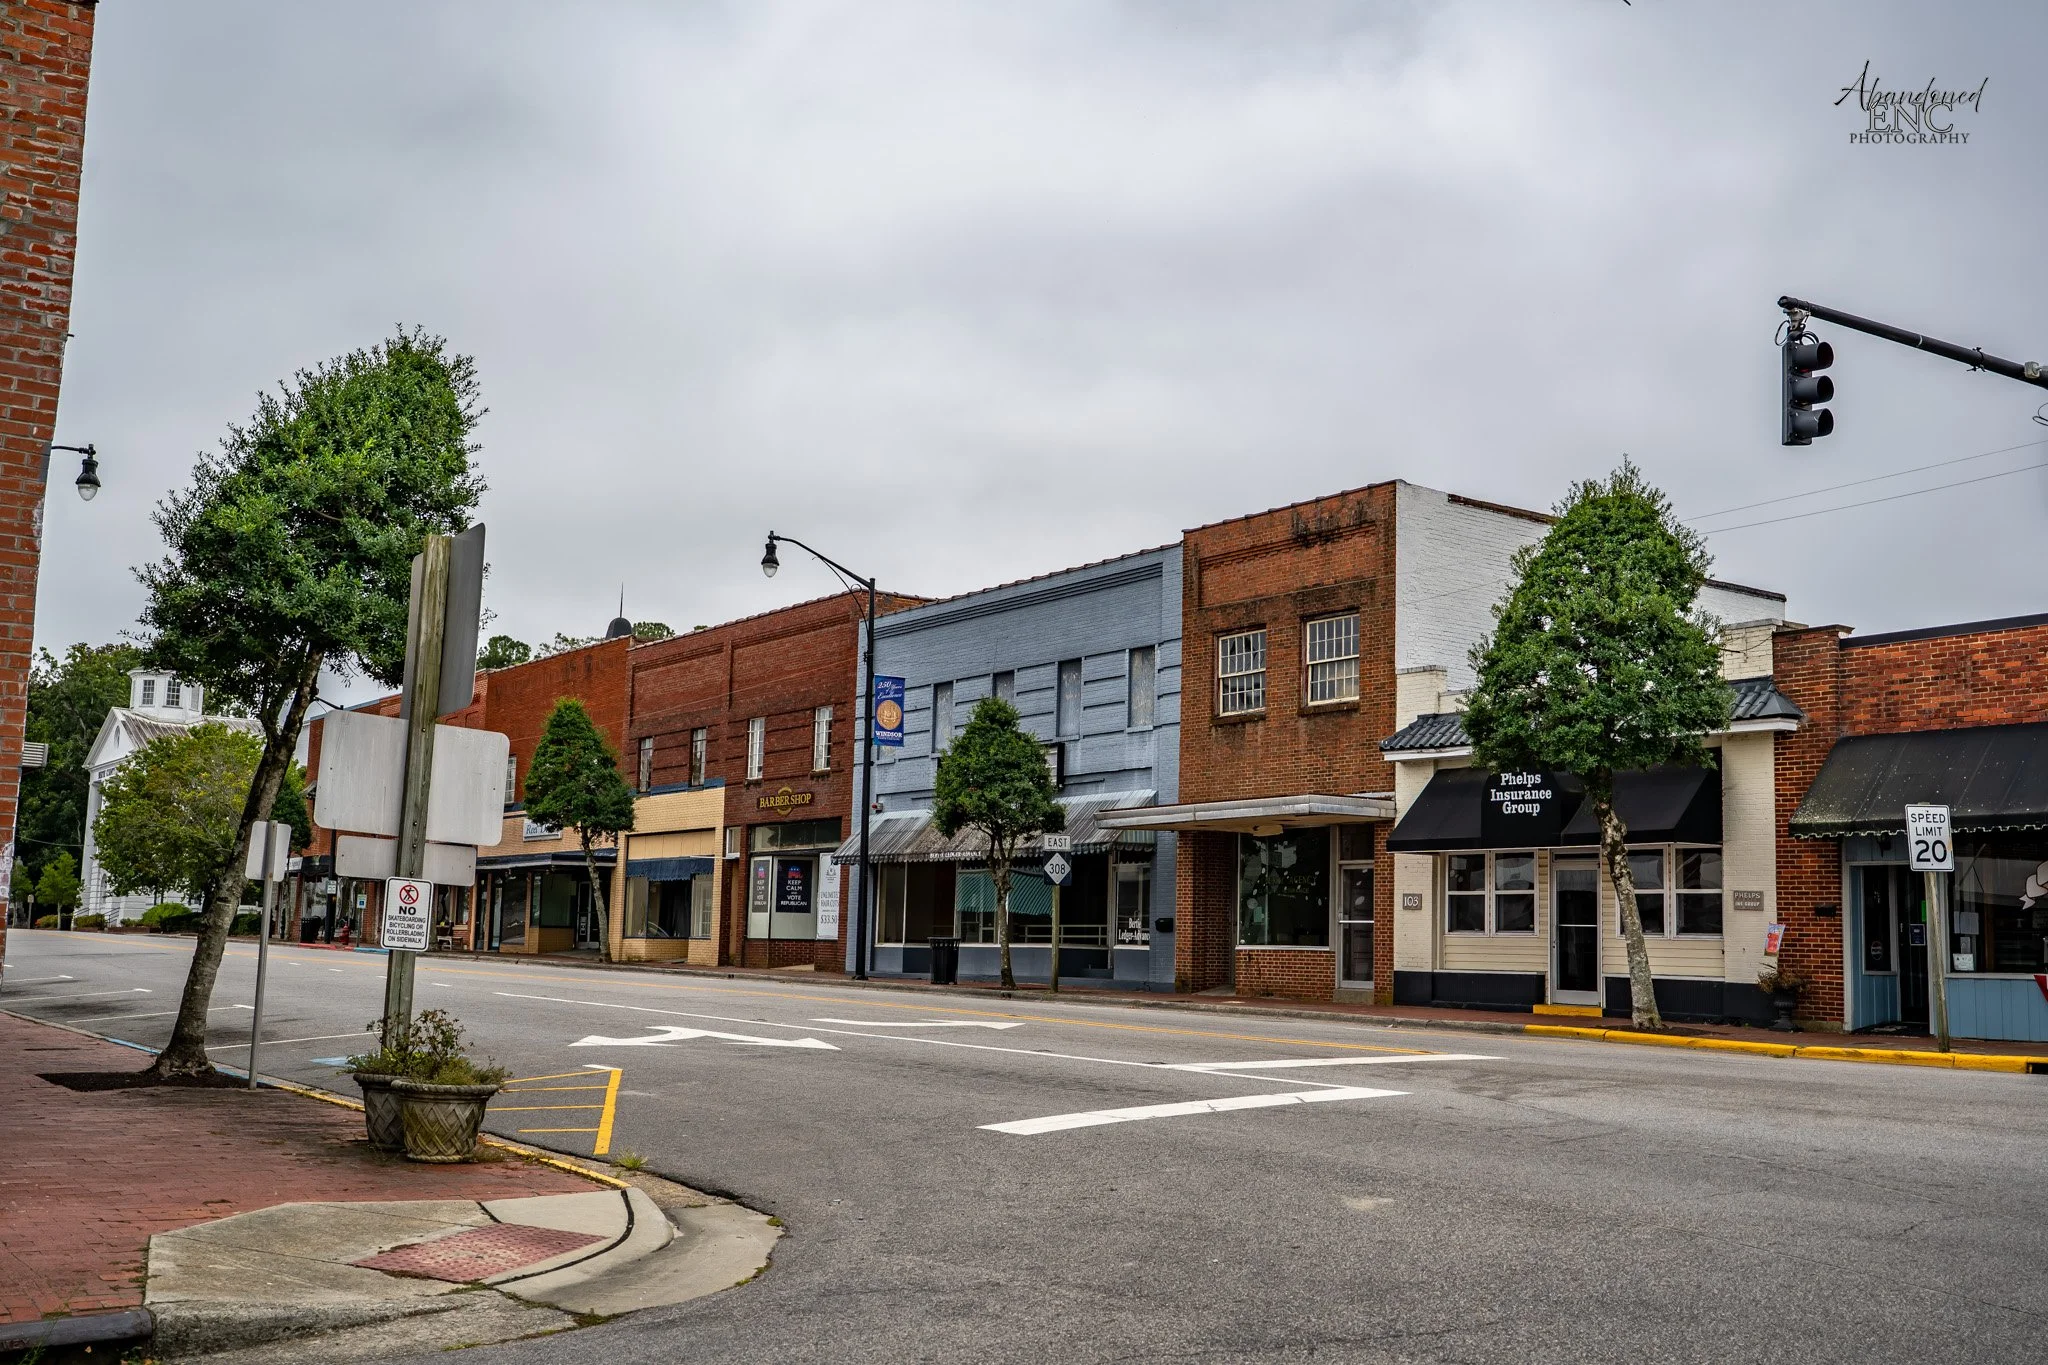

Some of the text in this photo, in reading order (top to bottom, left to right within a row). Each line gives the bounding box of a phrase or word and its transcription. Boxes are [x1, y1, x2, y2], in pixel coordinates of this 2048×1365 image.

[1500, 771, 1542, 788] Phelps
[760, 793, 811, 808] BARBER SHOP
[1490, 788, 1552, 802] Insurance
[1502, 801, 1541, 816] Group
[1910, 813, 1946, 824] SPEED
[1915, 826, 1943, 837] LIMIT
[1047, 837, 1067, 848] EAST
[1914, 839, 1947, 863] 20
[1049, 863, 1066, 874] 308
[1404, 896, 1419, 907] 103
[399, 906, 416, 915] NO
[388, 915, 426, 923] SKATEBOARDING
